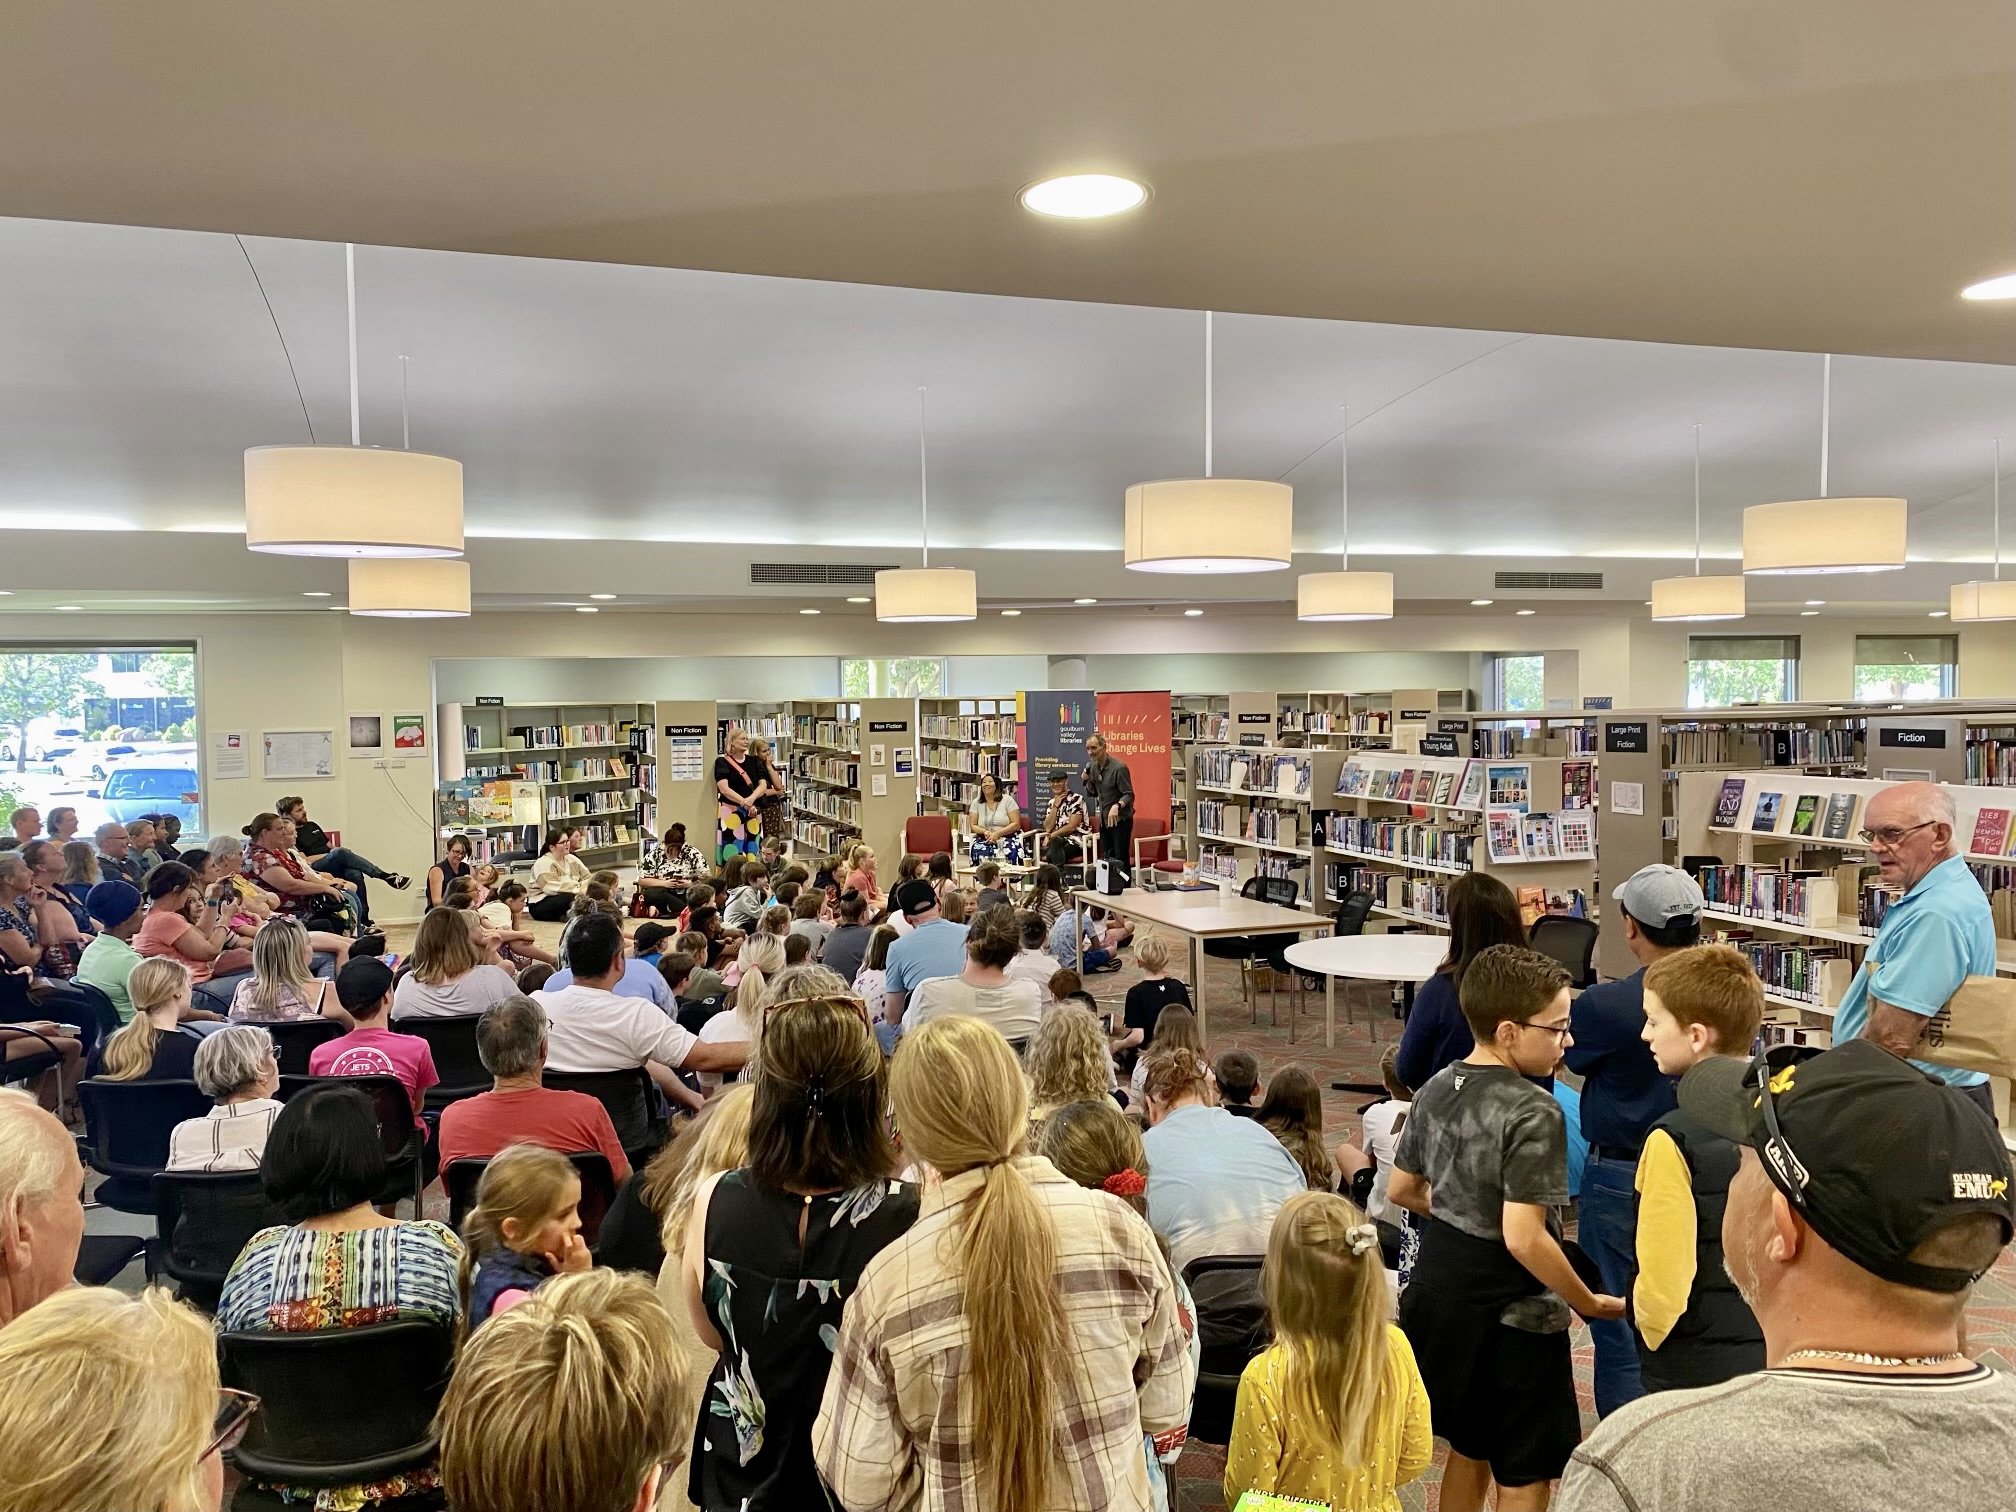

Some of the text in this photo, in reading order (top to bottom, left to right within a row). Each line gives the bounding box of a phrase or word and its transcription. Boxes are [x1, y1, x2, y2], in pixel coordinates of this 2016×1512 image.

[1103, 730, 1144, 740] Libraries
[1611, 726, 1626, 734] Large
[1898, 732, 1925, 743] Fiction
[1140, 743, 1166, 753] Lives
[1423, 742, 1453, 751] Young Adult
[1474, 740, 1479, 750] S
[1778, 743, 1786, 754] B
[1719, 800, 1739, 810] END
[1314, 822, 1323, 833] A
[1339, 876, 1347, 887] B
[1952, 1173, 1992, 1183] OLD MAN
[1954, 1182, 1992, 1199] EMU
[1247, 1488, 1274, 1497] ANDY
[1277, 1494, 1327, 1507] GRIFFITHS
